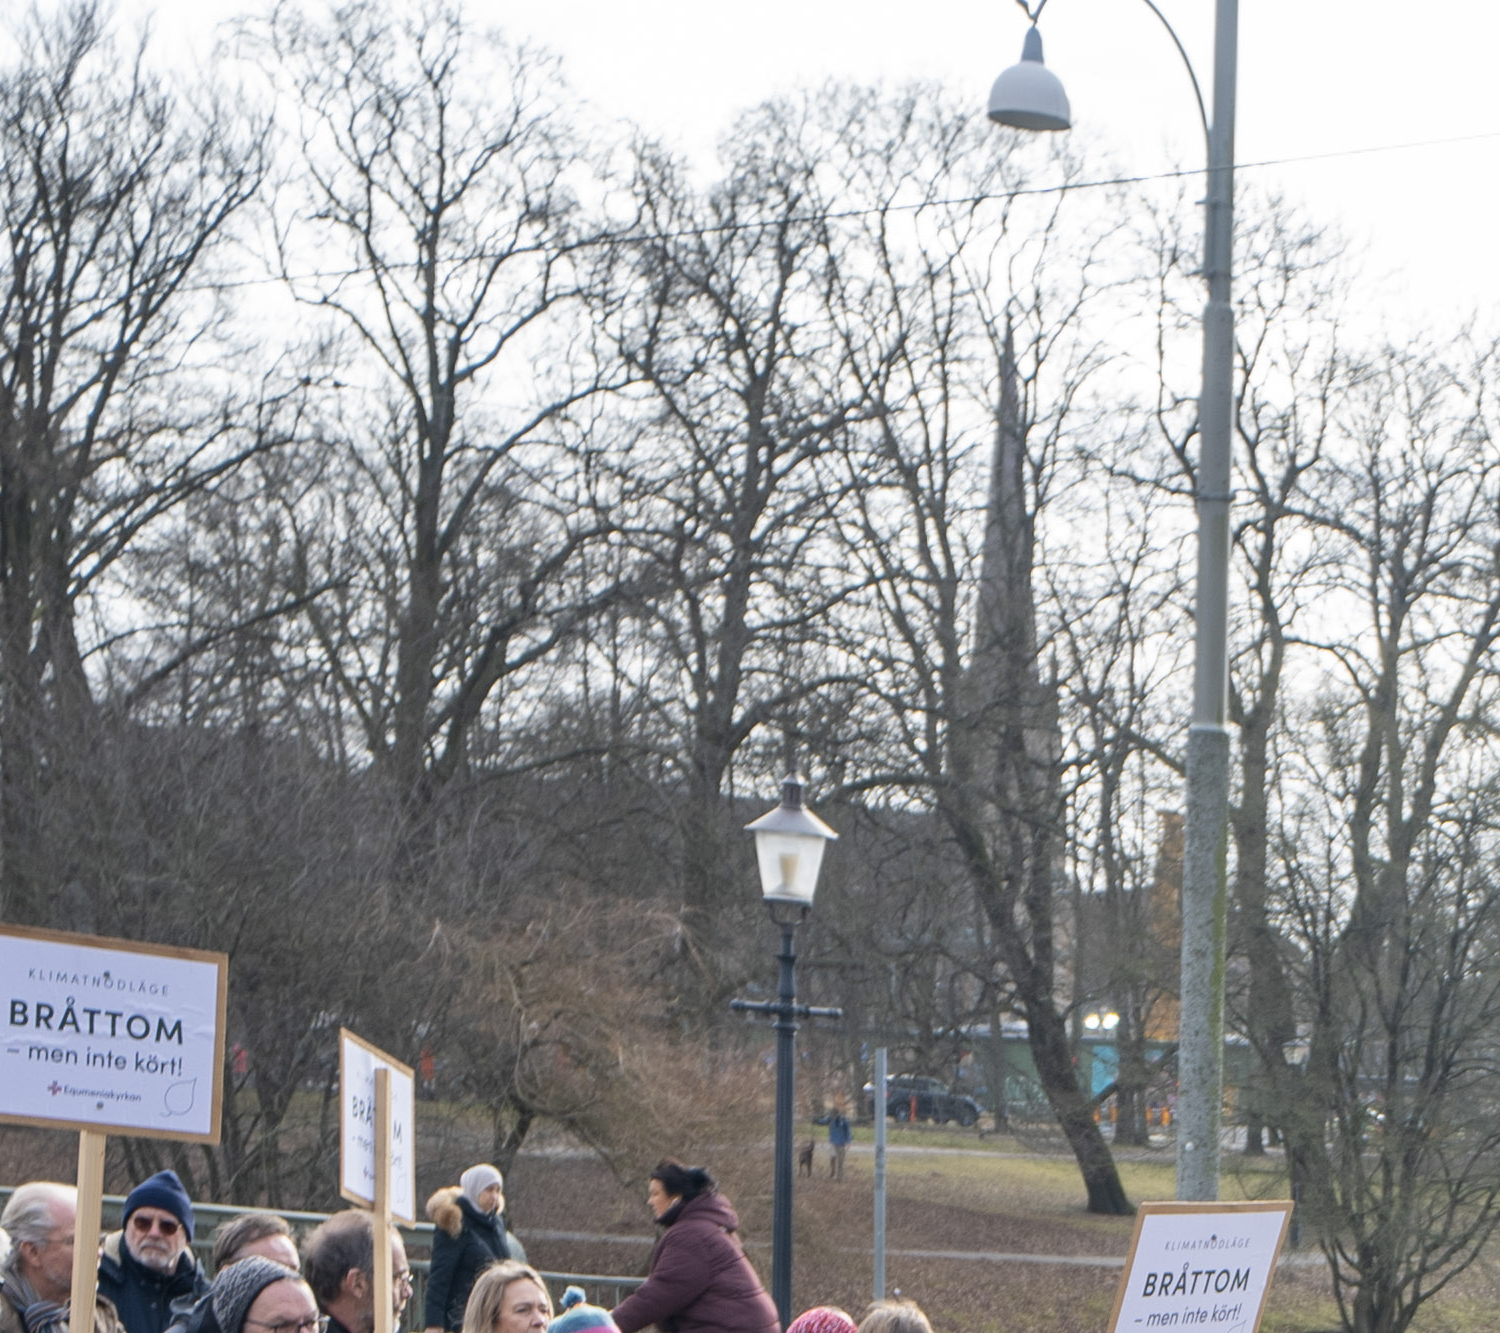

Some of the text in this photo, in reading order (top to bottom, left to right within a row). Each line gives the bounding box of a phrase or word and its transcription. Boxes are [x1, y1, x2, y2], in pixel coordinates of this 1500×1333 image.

[28, 967, 171, 996] KLIMATNÖDLÄGE
[9, 995, 184, 1045] BRÅTTOM
[28, 1044, 78, 1065] men
[86, 1046, 127, 1070] inte
[134, 1051, 184, 1077] kört!
[62, 1084, 142, 1103] Equmeniakyrkan
[352, 1095, 402, 1145] BRÅM
[1164, 1236, 1251, 1252] KLIMATNÖDLÄGE
[1142, 1261, 1251, 1298] BRÅTTOM
[1146, 1311, 1179, 1327] men
[1181, 1306, 1208, 1325] inte
[1211, 1302, 1243, 1323] kört!
